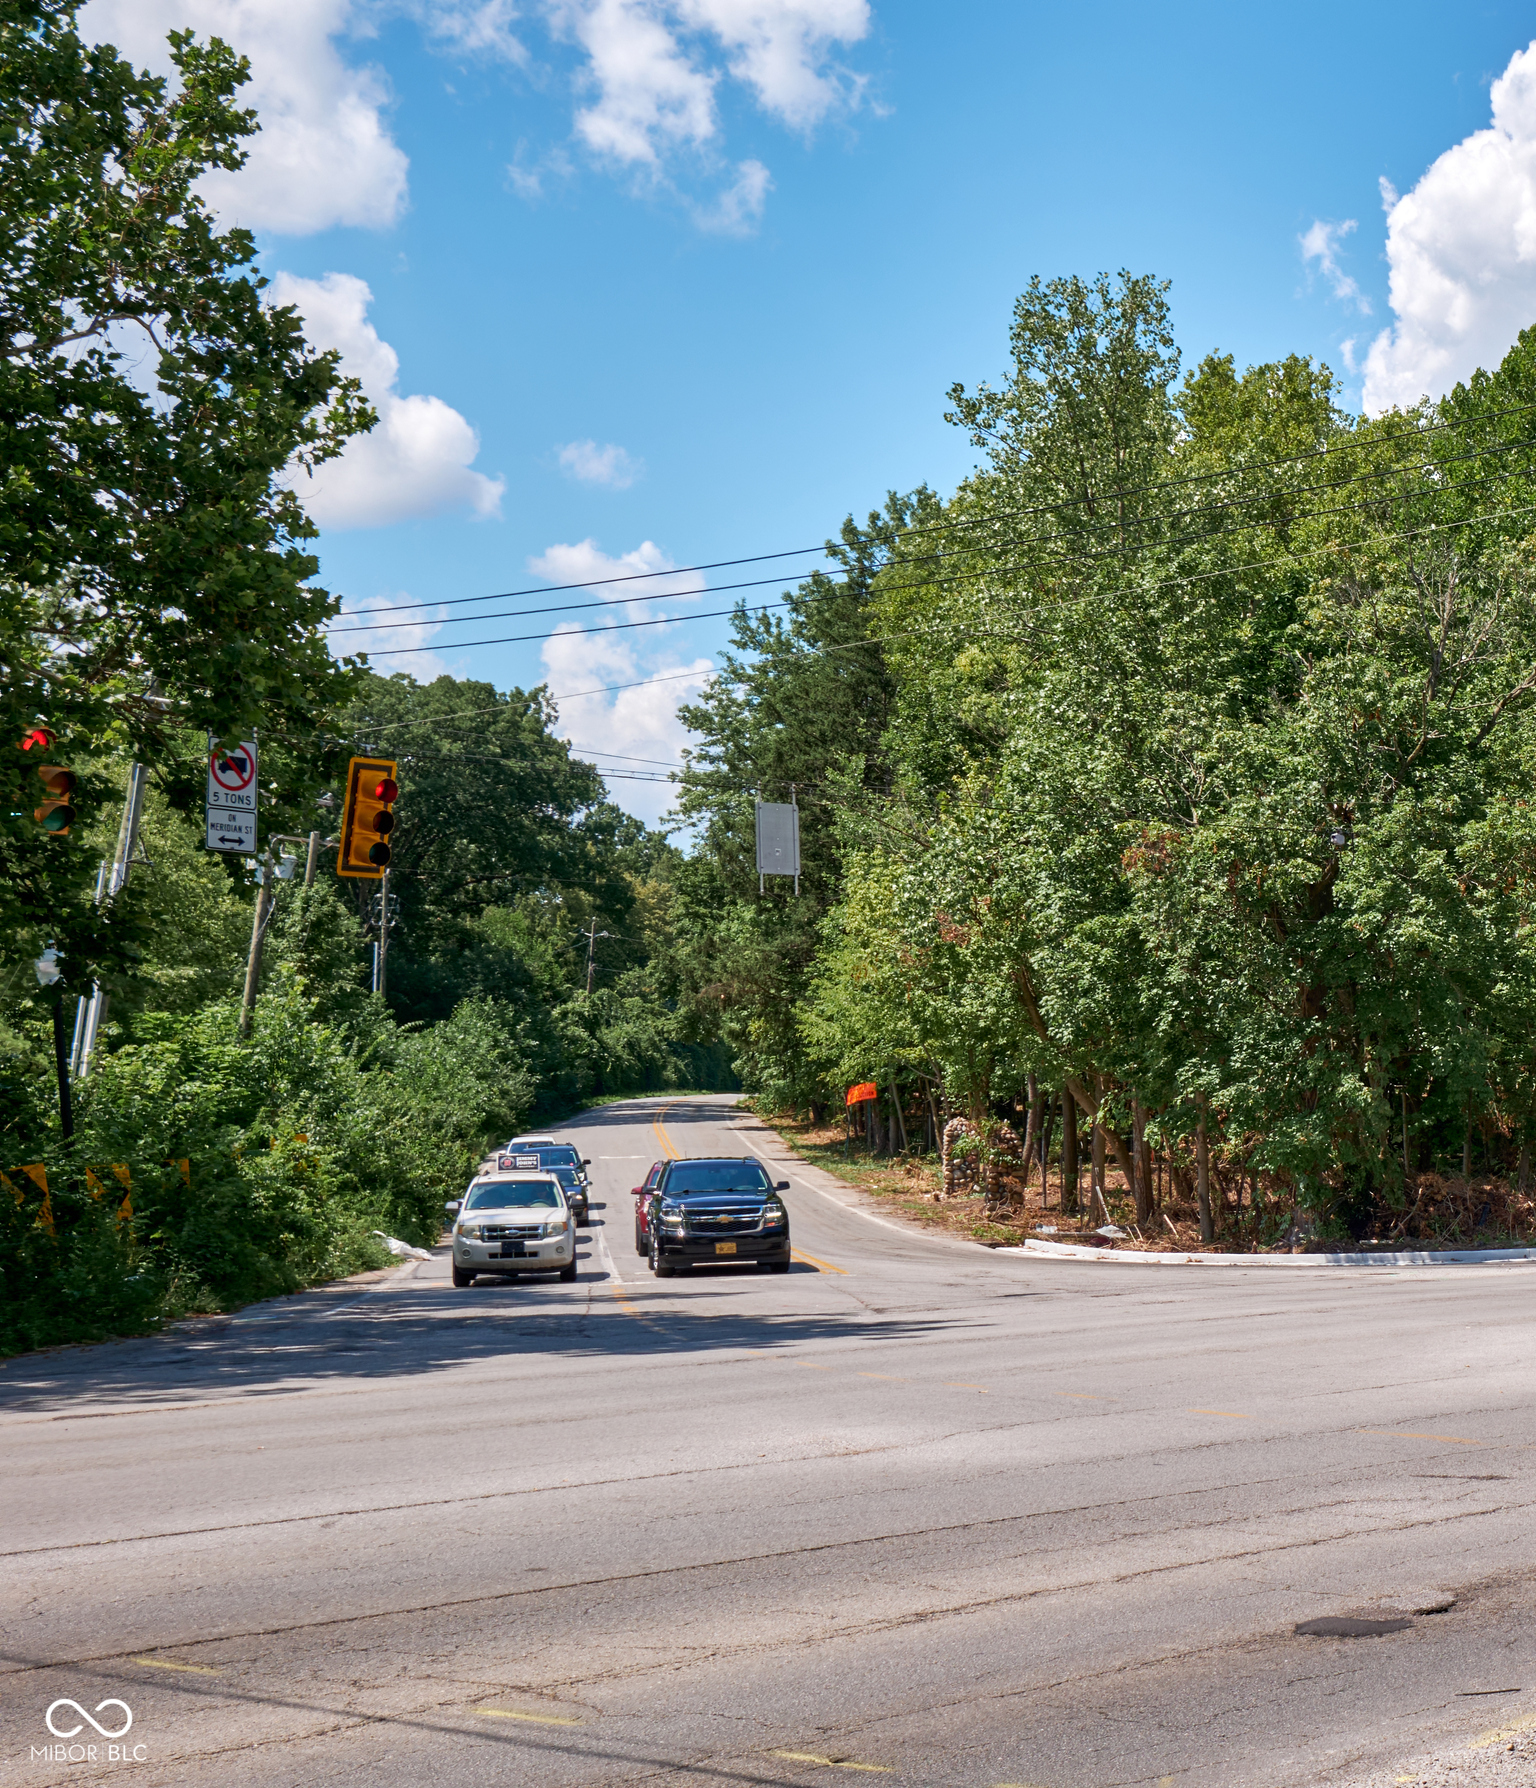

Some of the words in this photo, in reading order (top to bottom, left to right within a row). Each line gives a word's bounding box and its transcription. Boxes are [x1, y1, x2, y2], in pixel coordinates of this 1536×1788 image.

[213, 792, 220, 802] 5
[224, 792, 252, 806] TONS
[228, 814, 236, 822] ON
[210, 822, 242, 833] MERIDIAN
[244, 826, 253, 834] ST
